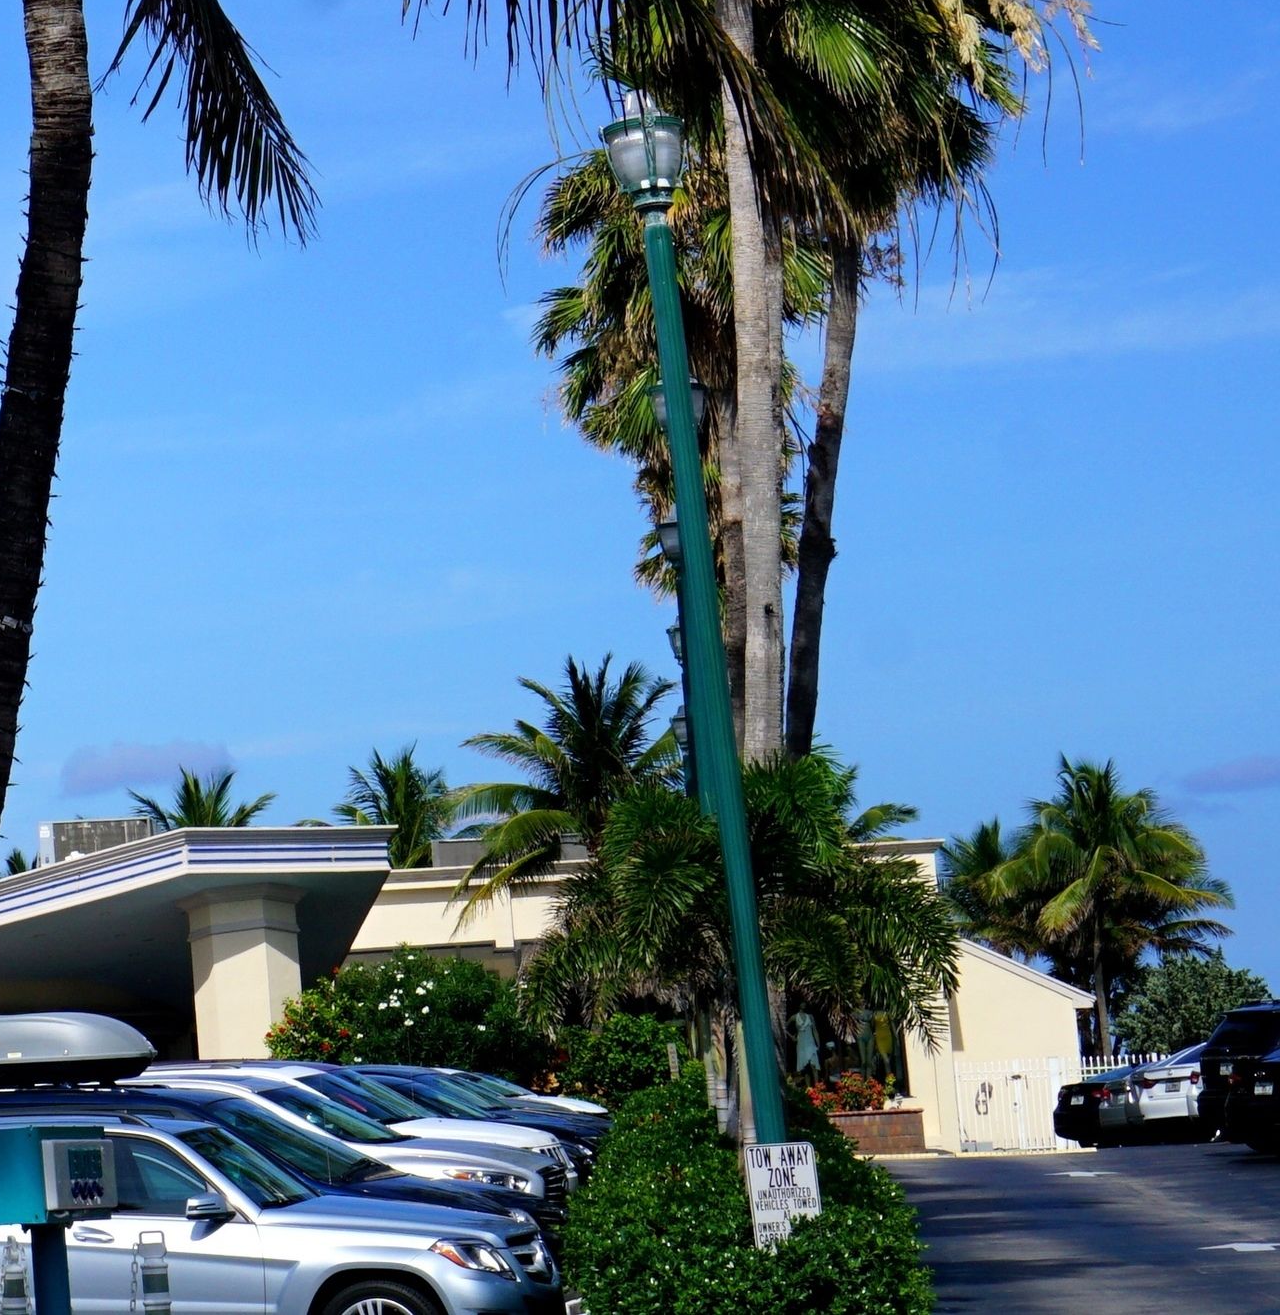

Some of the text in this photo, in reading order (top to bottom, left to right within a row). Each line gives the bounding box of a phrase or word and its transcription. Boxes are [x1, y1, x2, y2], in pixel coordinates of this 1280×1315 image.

[749, 1146, 808, 1168] TOW AWAY
[767, 1167, 797, 1187] ZONE
[757, 1187, 811, 1200] UNAUTHORIZED
[755, 1197, 817, 1211] VEHICLES TOWED
[757, 1221, 787, 1233] OWNER'S
